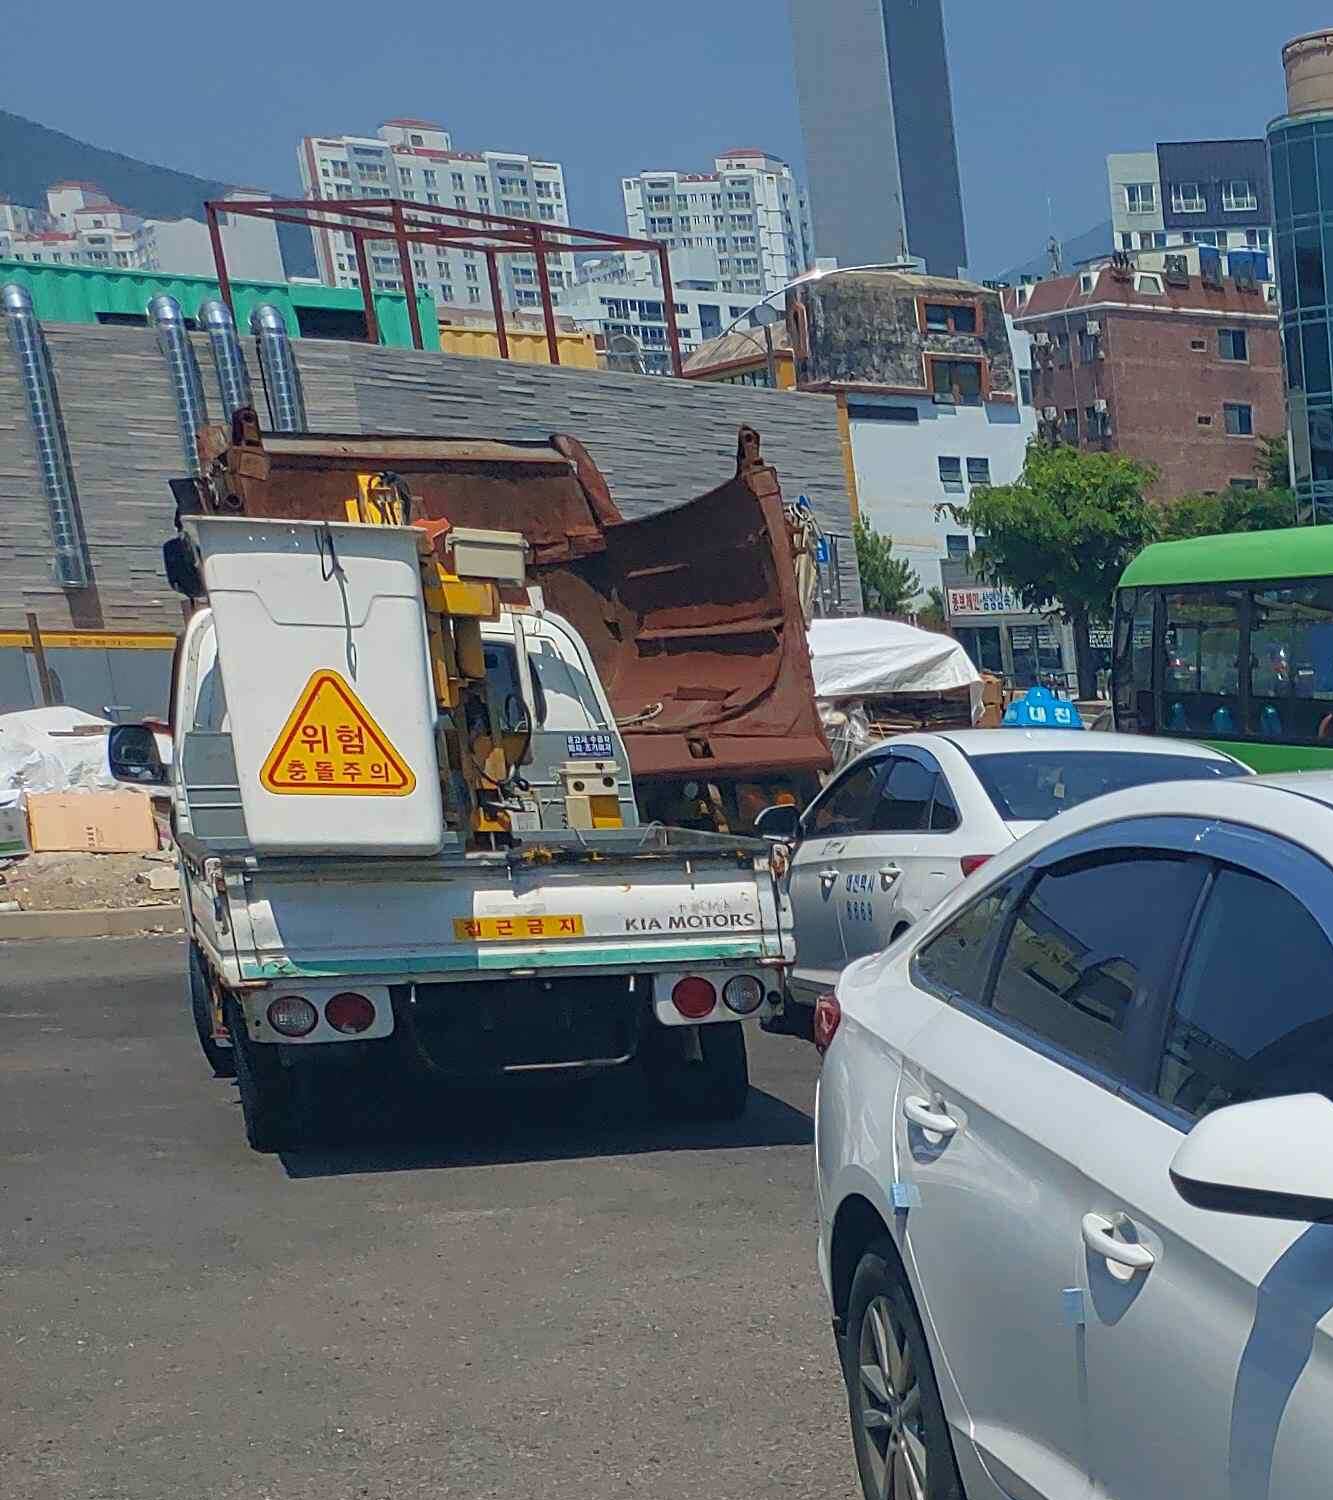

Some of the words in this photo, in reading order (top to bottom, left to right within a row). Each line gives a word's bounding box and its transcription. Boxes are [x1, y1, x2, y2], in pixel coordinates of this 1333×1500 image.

[301, 725, 365, 754] 위험
[625, 917, 662, 931] KIA
[668, 913, 755, 929] MOTORS
